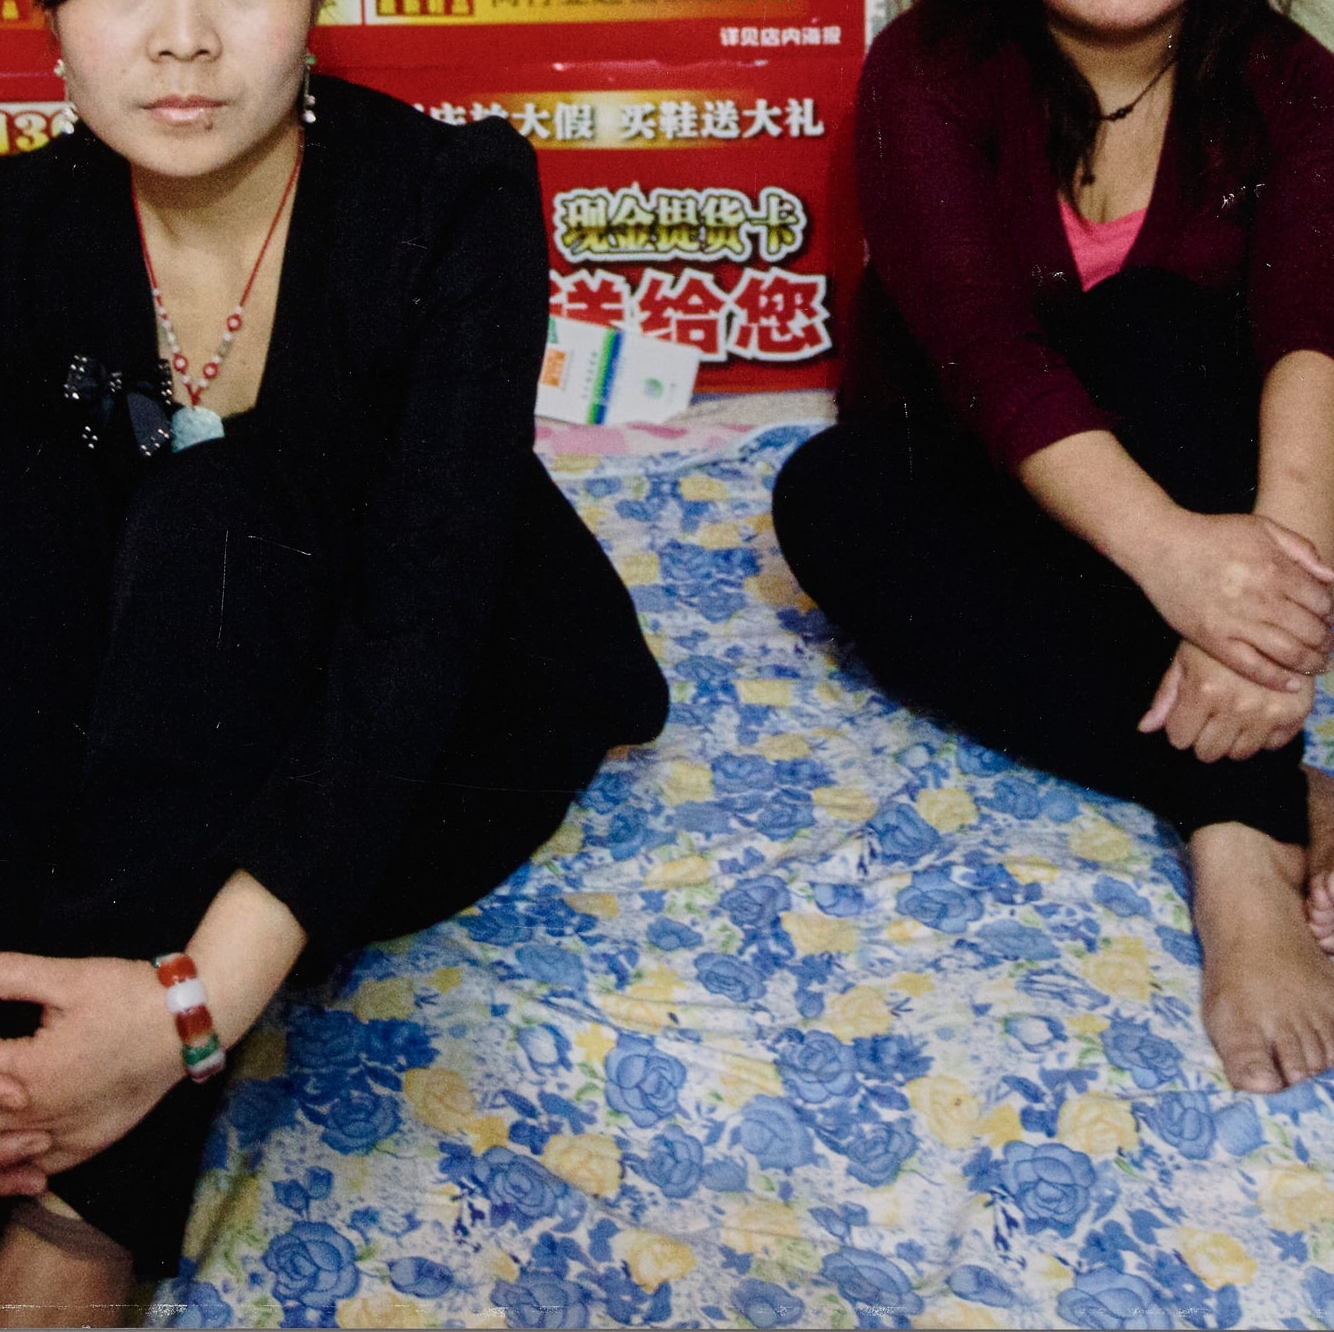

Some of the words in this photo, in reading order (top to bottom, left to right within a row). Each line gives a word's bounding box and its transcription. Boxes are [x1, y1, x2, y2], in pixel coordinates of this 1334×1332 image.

[620, 98, 825, 140] 买鞋送大礼
[554, 182, 807, 263] 现金提货卡
